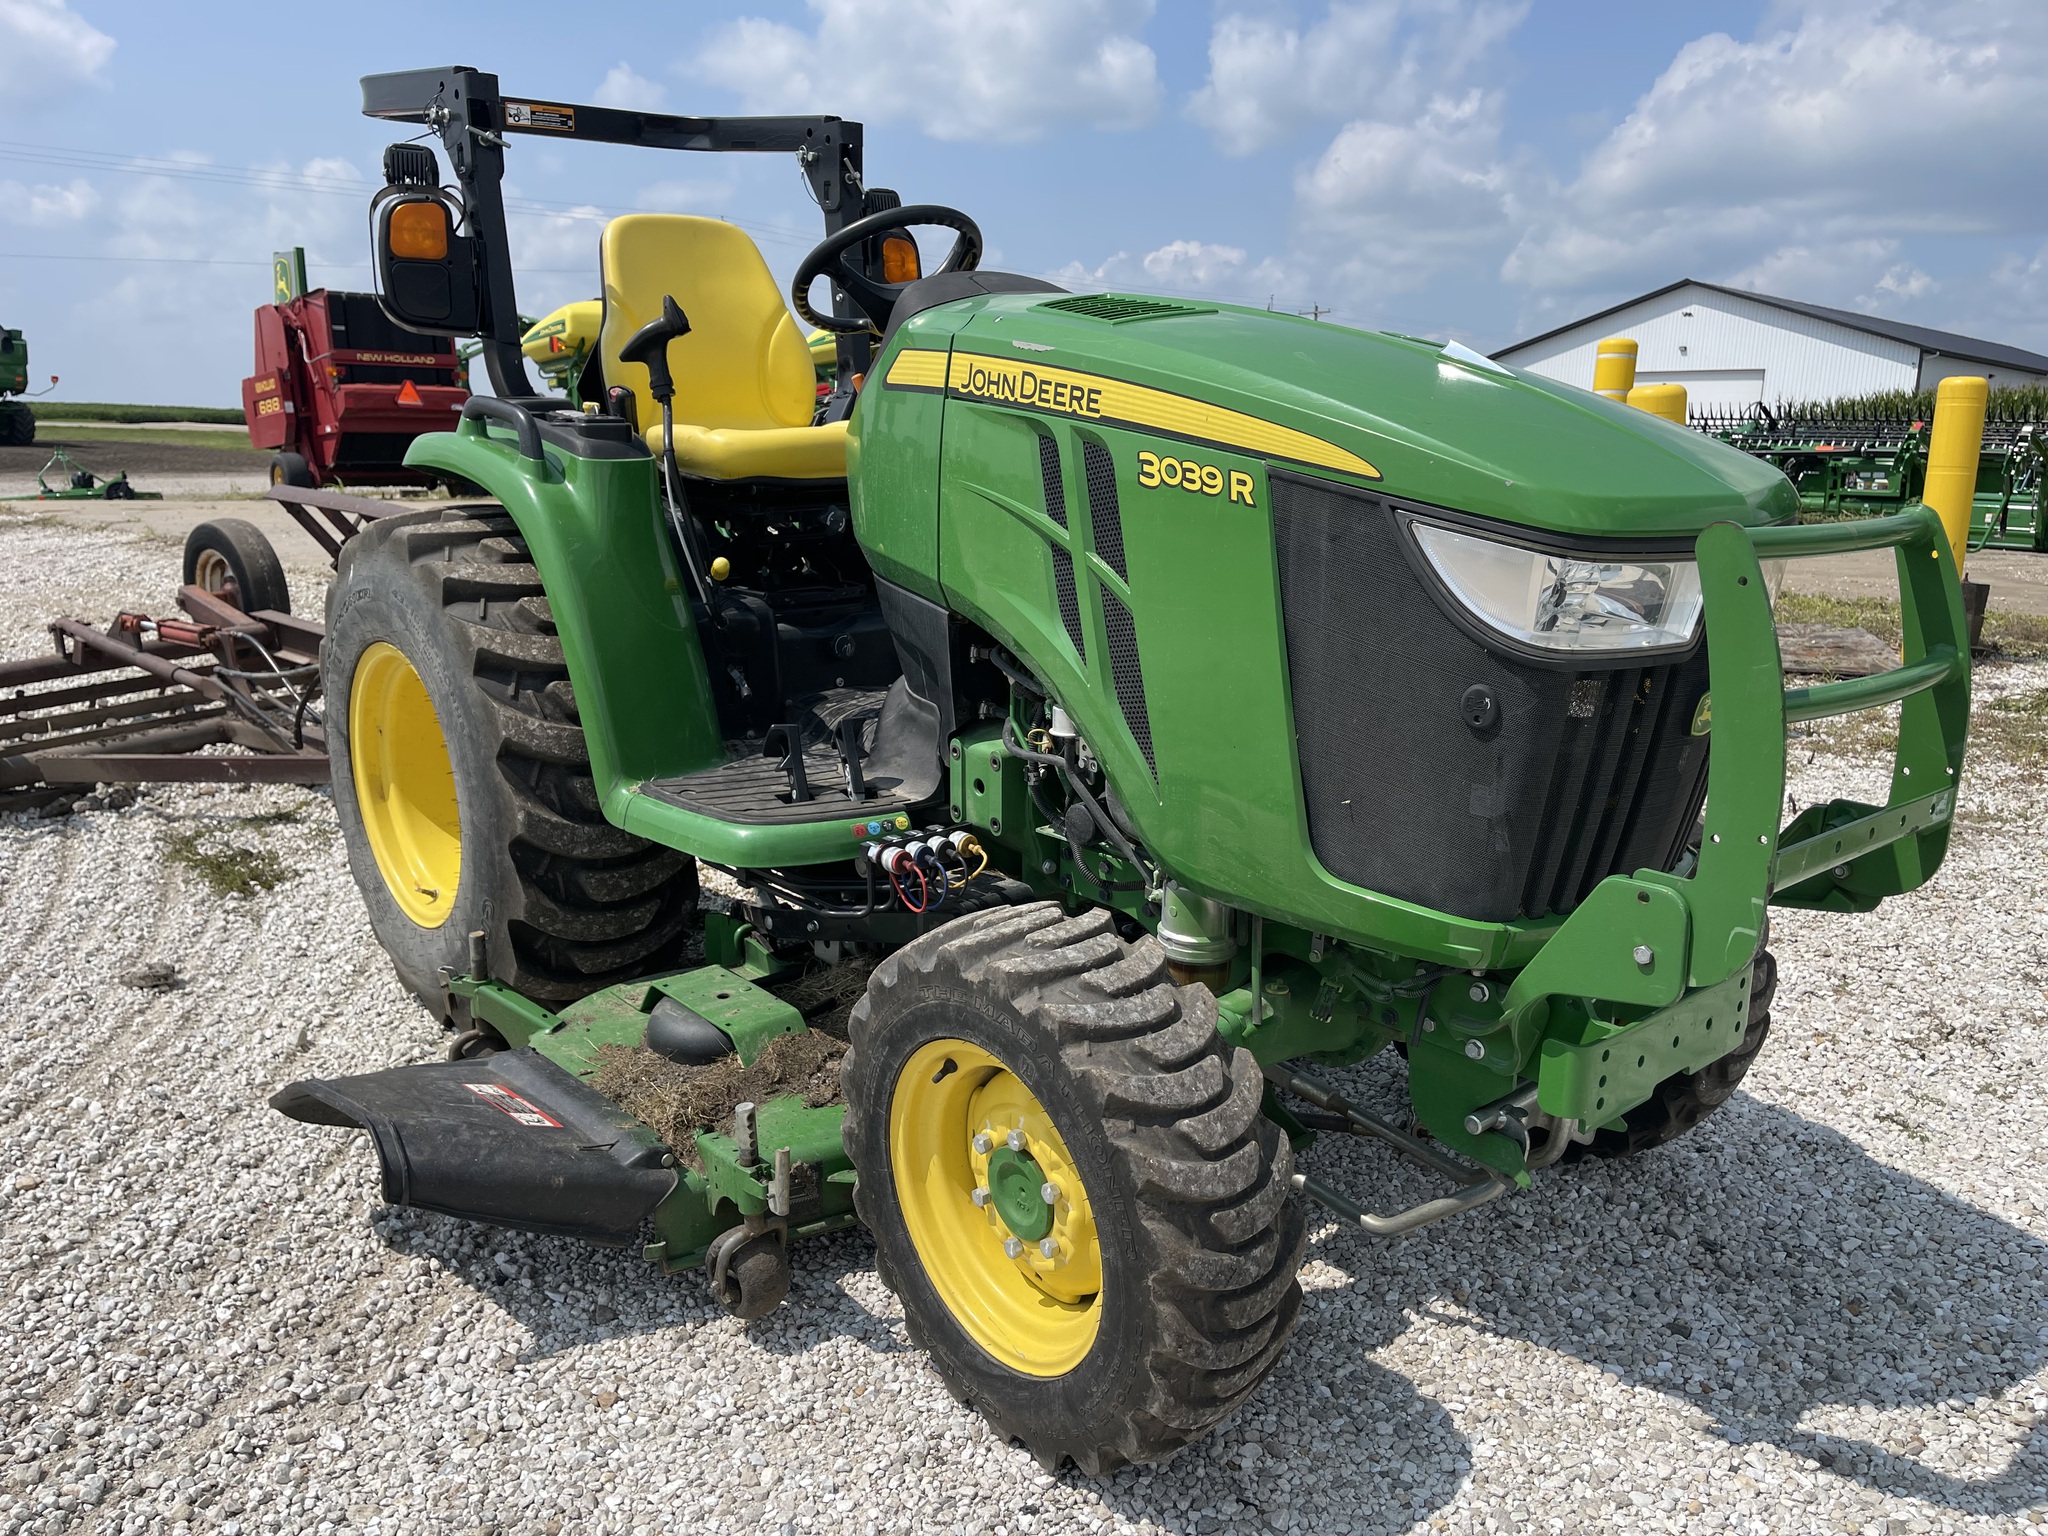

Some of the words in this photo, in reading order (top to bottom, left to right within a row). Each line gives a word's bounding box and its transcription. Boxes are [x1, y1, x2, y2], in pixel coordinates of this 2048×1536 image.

[356, 352, 382, 362] NEW
[384, 354, 436, 365] HOLLAND
[258, 396, 281, 415] 688
[960, 363, 1017, 401] JOHN
[1020, 370, 1102, 415] DEERE
[1138, 450, 1223, 494] 3039
[1228, 472, 1257, 507] R
[918, 984, 968, 1004] THE
[972, 993, 1139, 1263] MARATHONER
